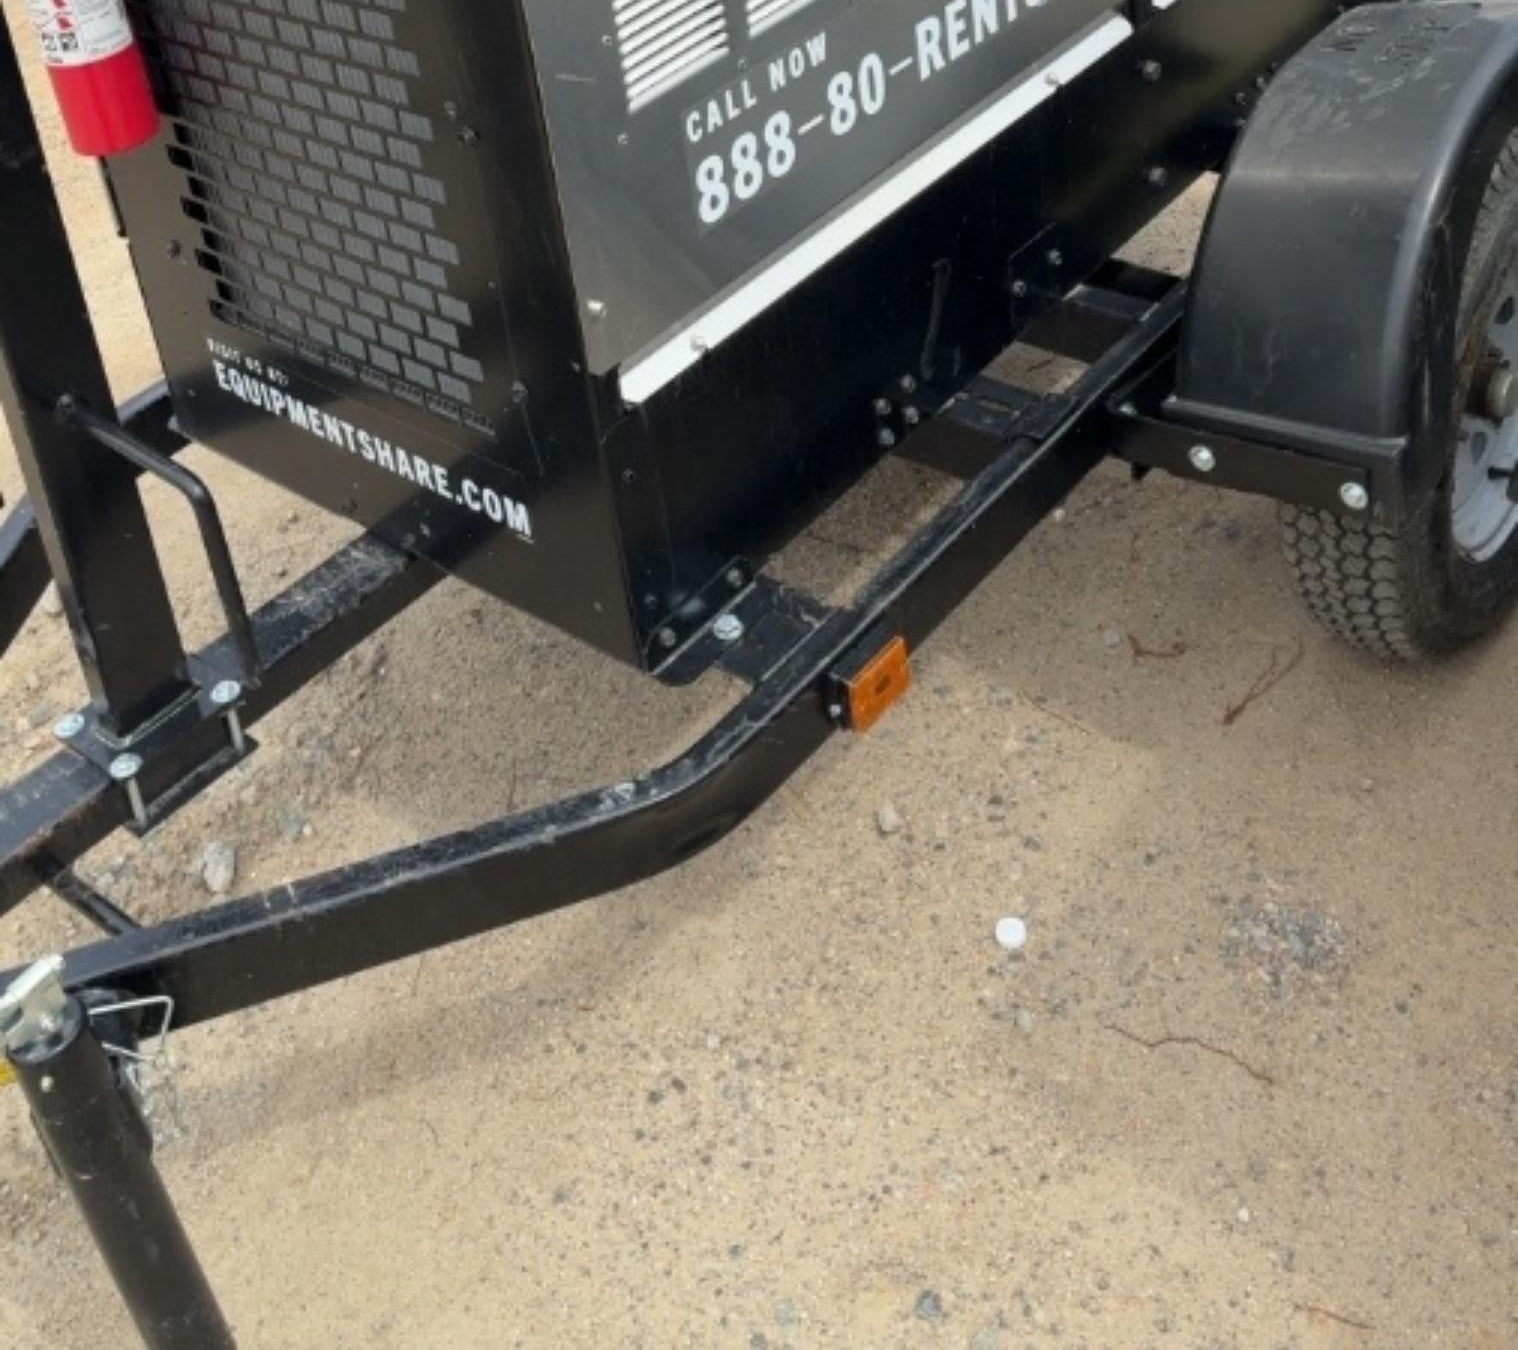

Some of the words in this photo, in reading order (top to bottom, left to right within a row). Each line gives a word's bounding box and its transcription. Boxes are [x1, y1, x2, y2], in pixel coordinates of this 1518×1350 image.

[685, 79, 757, 142] CALL
[768, 31, 826, 91] NOW
[212, 359, 533, 536] EQUIPMENTSHARE.COM
